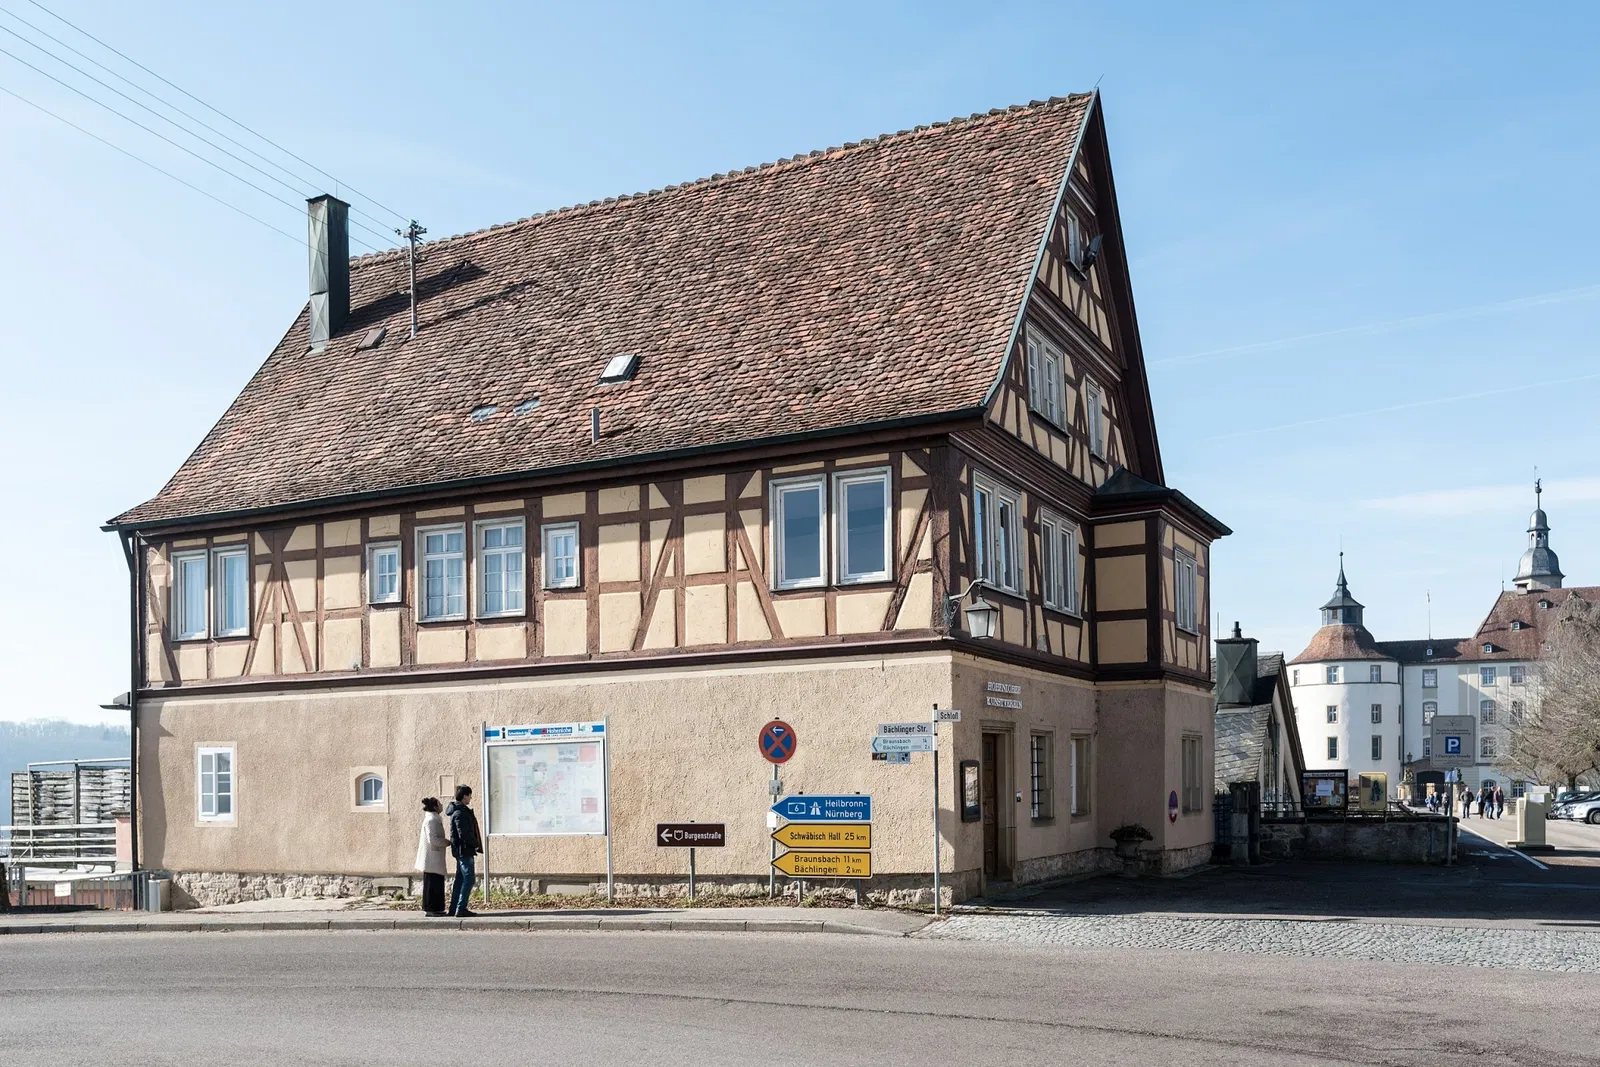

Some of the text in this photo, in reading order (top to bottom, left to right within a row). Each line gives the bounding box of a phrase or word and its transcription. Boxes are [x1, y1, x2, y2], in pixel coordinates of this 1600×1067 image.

[940, 711, 959, 720] Schloß
[883, 724, 928, 735] Bächlinger Str.
[1447, 738, 1459, 752] P
[825, 810, 863, 819] Nürnberg
[684, 831, 722, 841] Burgenstraße
[789, 831, 826, 840] Schwäbisch
[828, 832, 841, 840] Hall
[844, 832, 855, 840] 25
[794, 854, 841, 863] Braunsbach
[794, 865, 838, 875] Bächlingen
